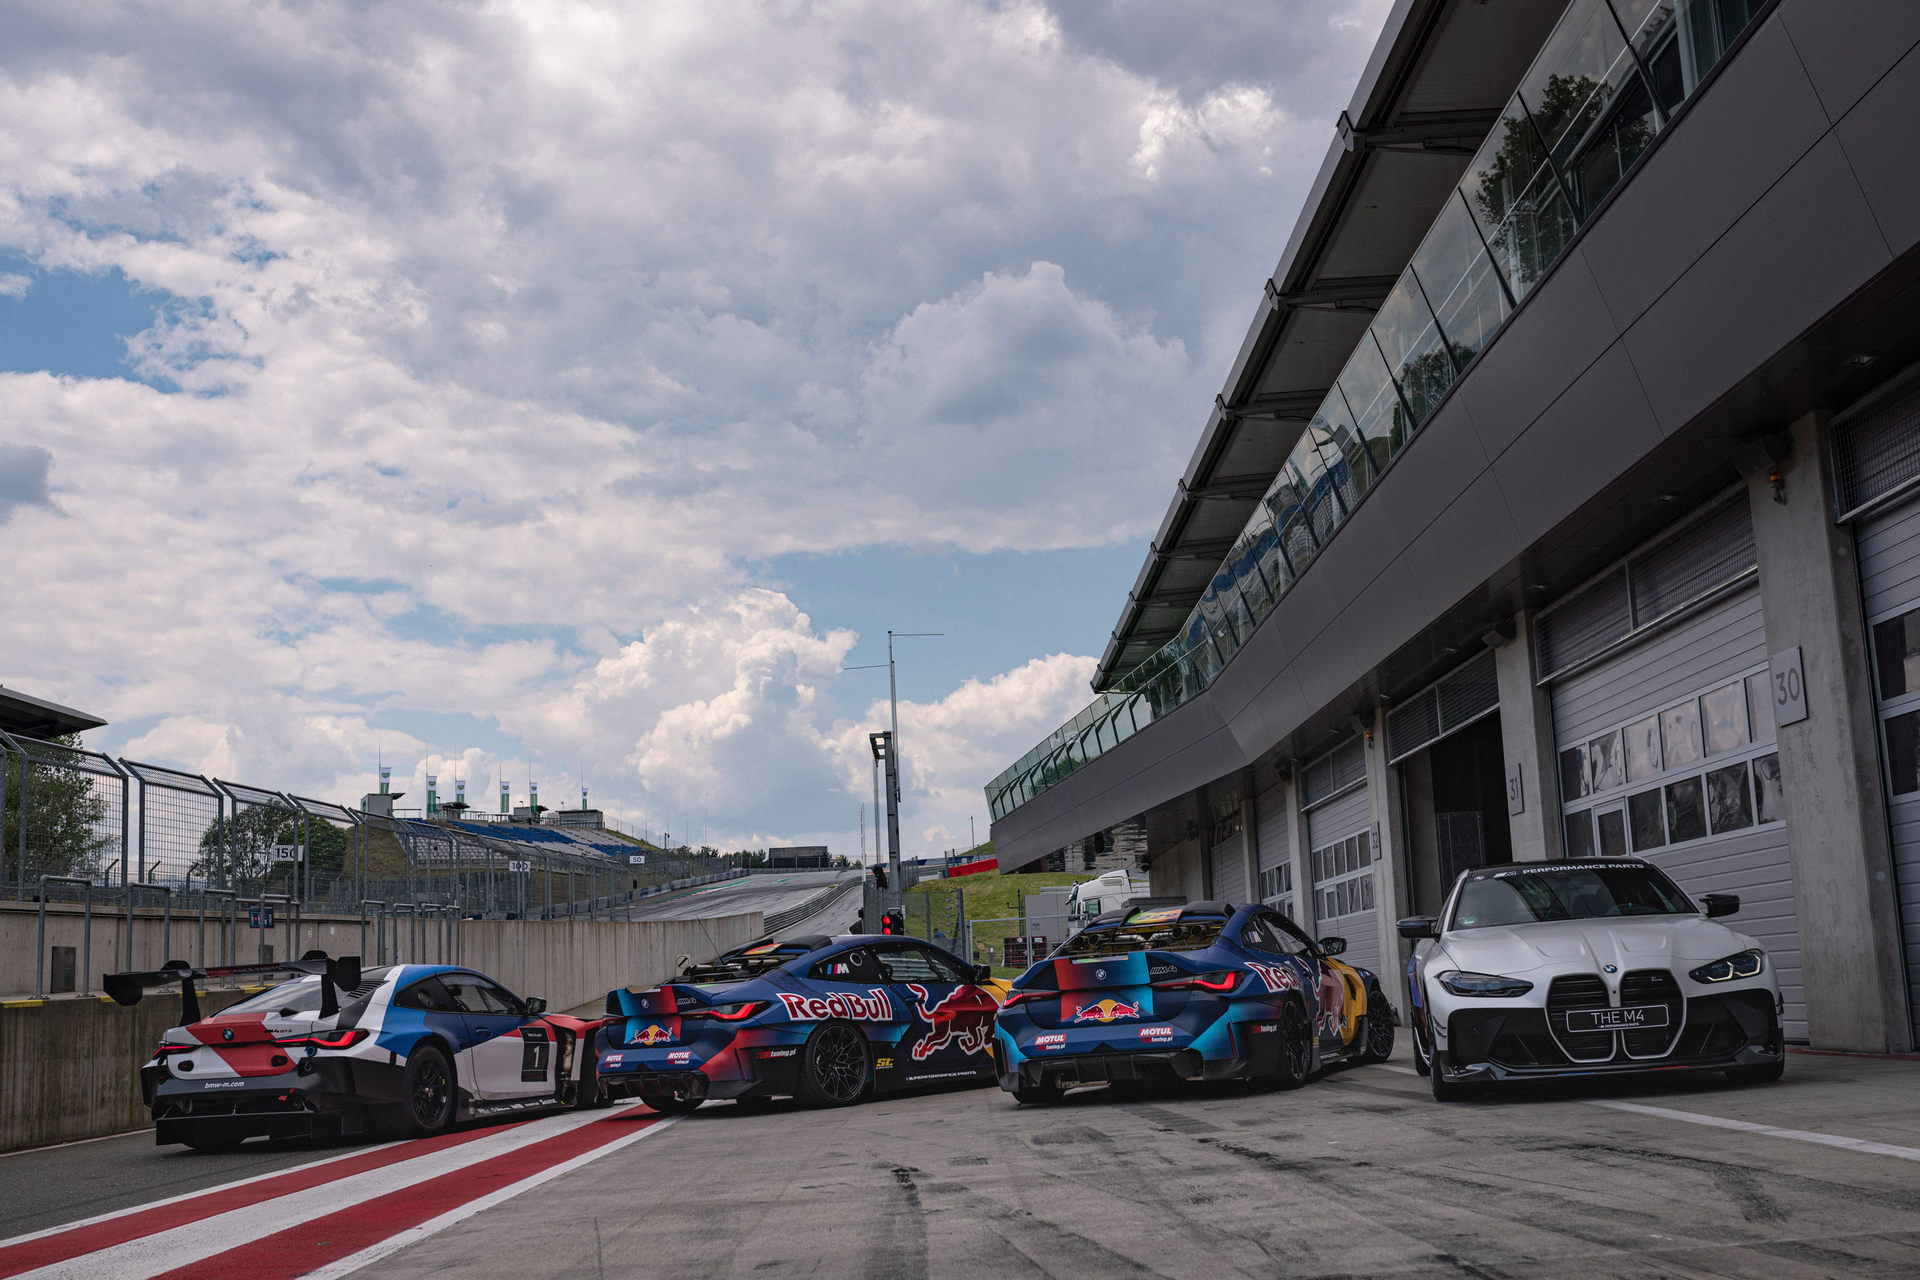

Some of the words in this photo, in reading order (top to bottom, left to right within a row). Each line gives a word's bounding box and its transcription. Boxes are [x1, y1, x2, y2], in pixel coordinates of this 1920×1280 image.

[1776, 668, 1800, 706] 30
[1509, 777, 1520, 801] 31
[1522, 864, 1606, 874] PERFORMANCE
[776, 992, 850, 1020] Red
[838, 988, 893, 1022] Bull
[1590, 1011, 1620, 1024] THE
[1624, 1010, 1644, 1022] M4
[1140, 1027, 1172, 1036] MOTUL
[1036, 1034, 1064, 1044] MOTUL
[534, 1045, 540, 1068] 1
[914, 1072, 957, 1080] PERFORMANCE
